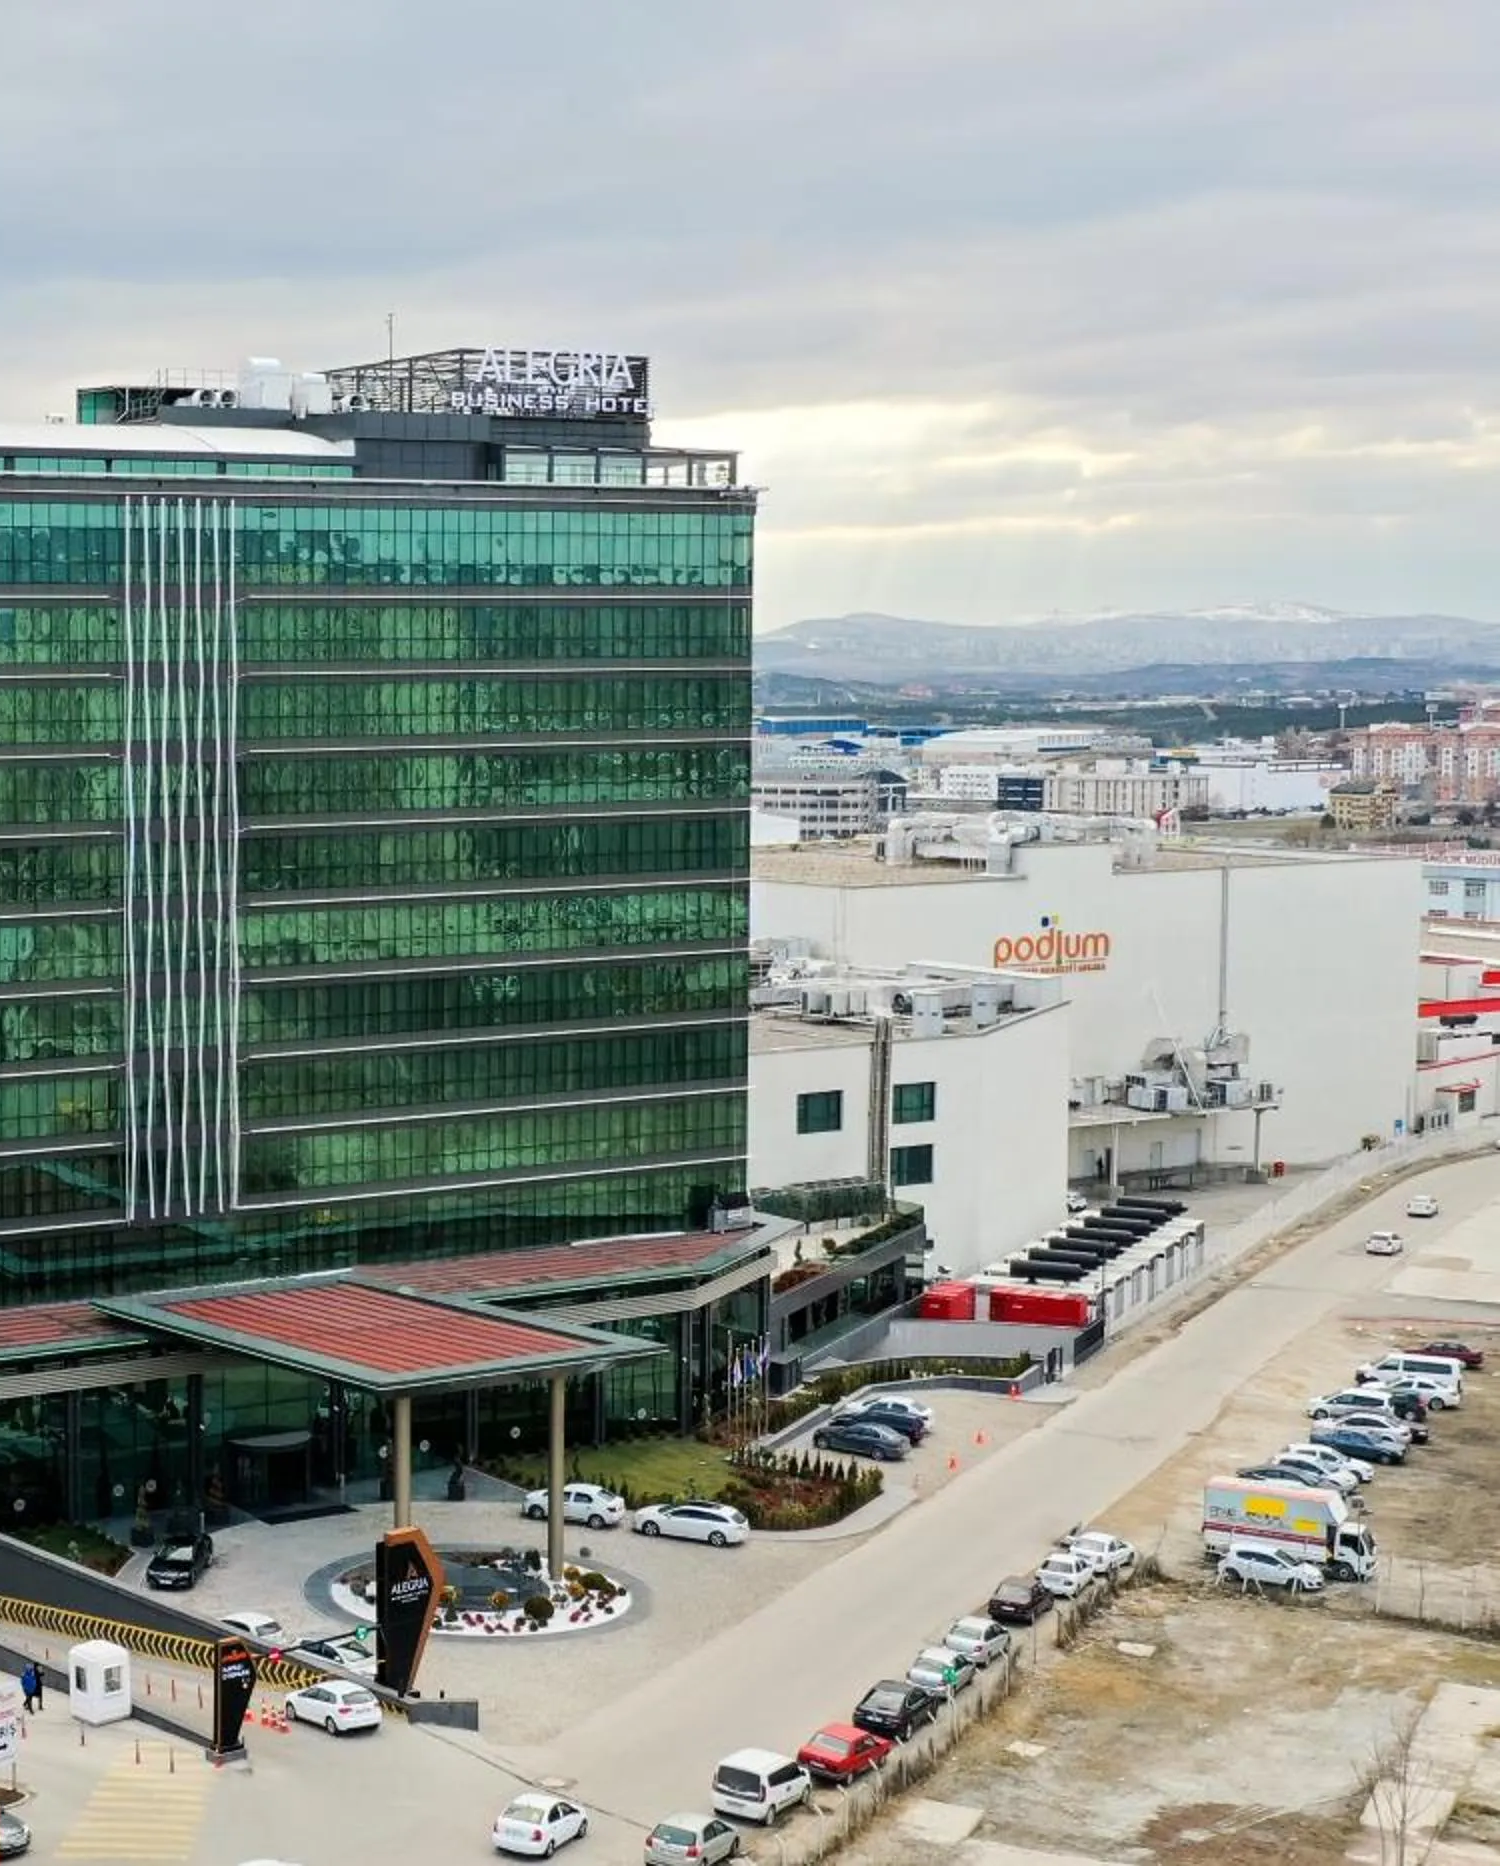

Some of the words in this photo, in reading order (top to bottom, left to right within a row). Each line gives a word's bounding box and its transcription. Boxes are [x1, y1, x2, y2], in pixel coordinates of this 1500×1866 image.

[476, 346, 634, 389] ALEGRIA
[451, 391, 570, 410] BUSINESS
[993, 915, 1110, 968] podium
